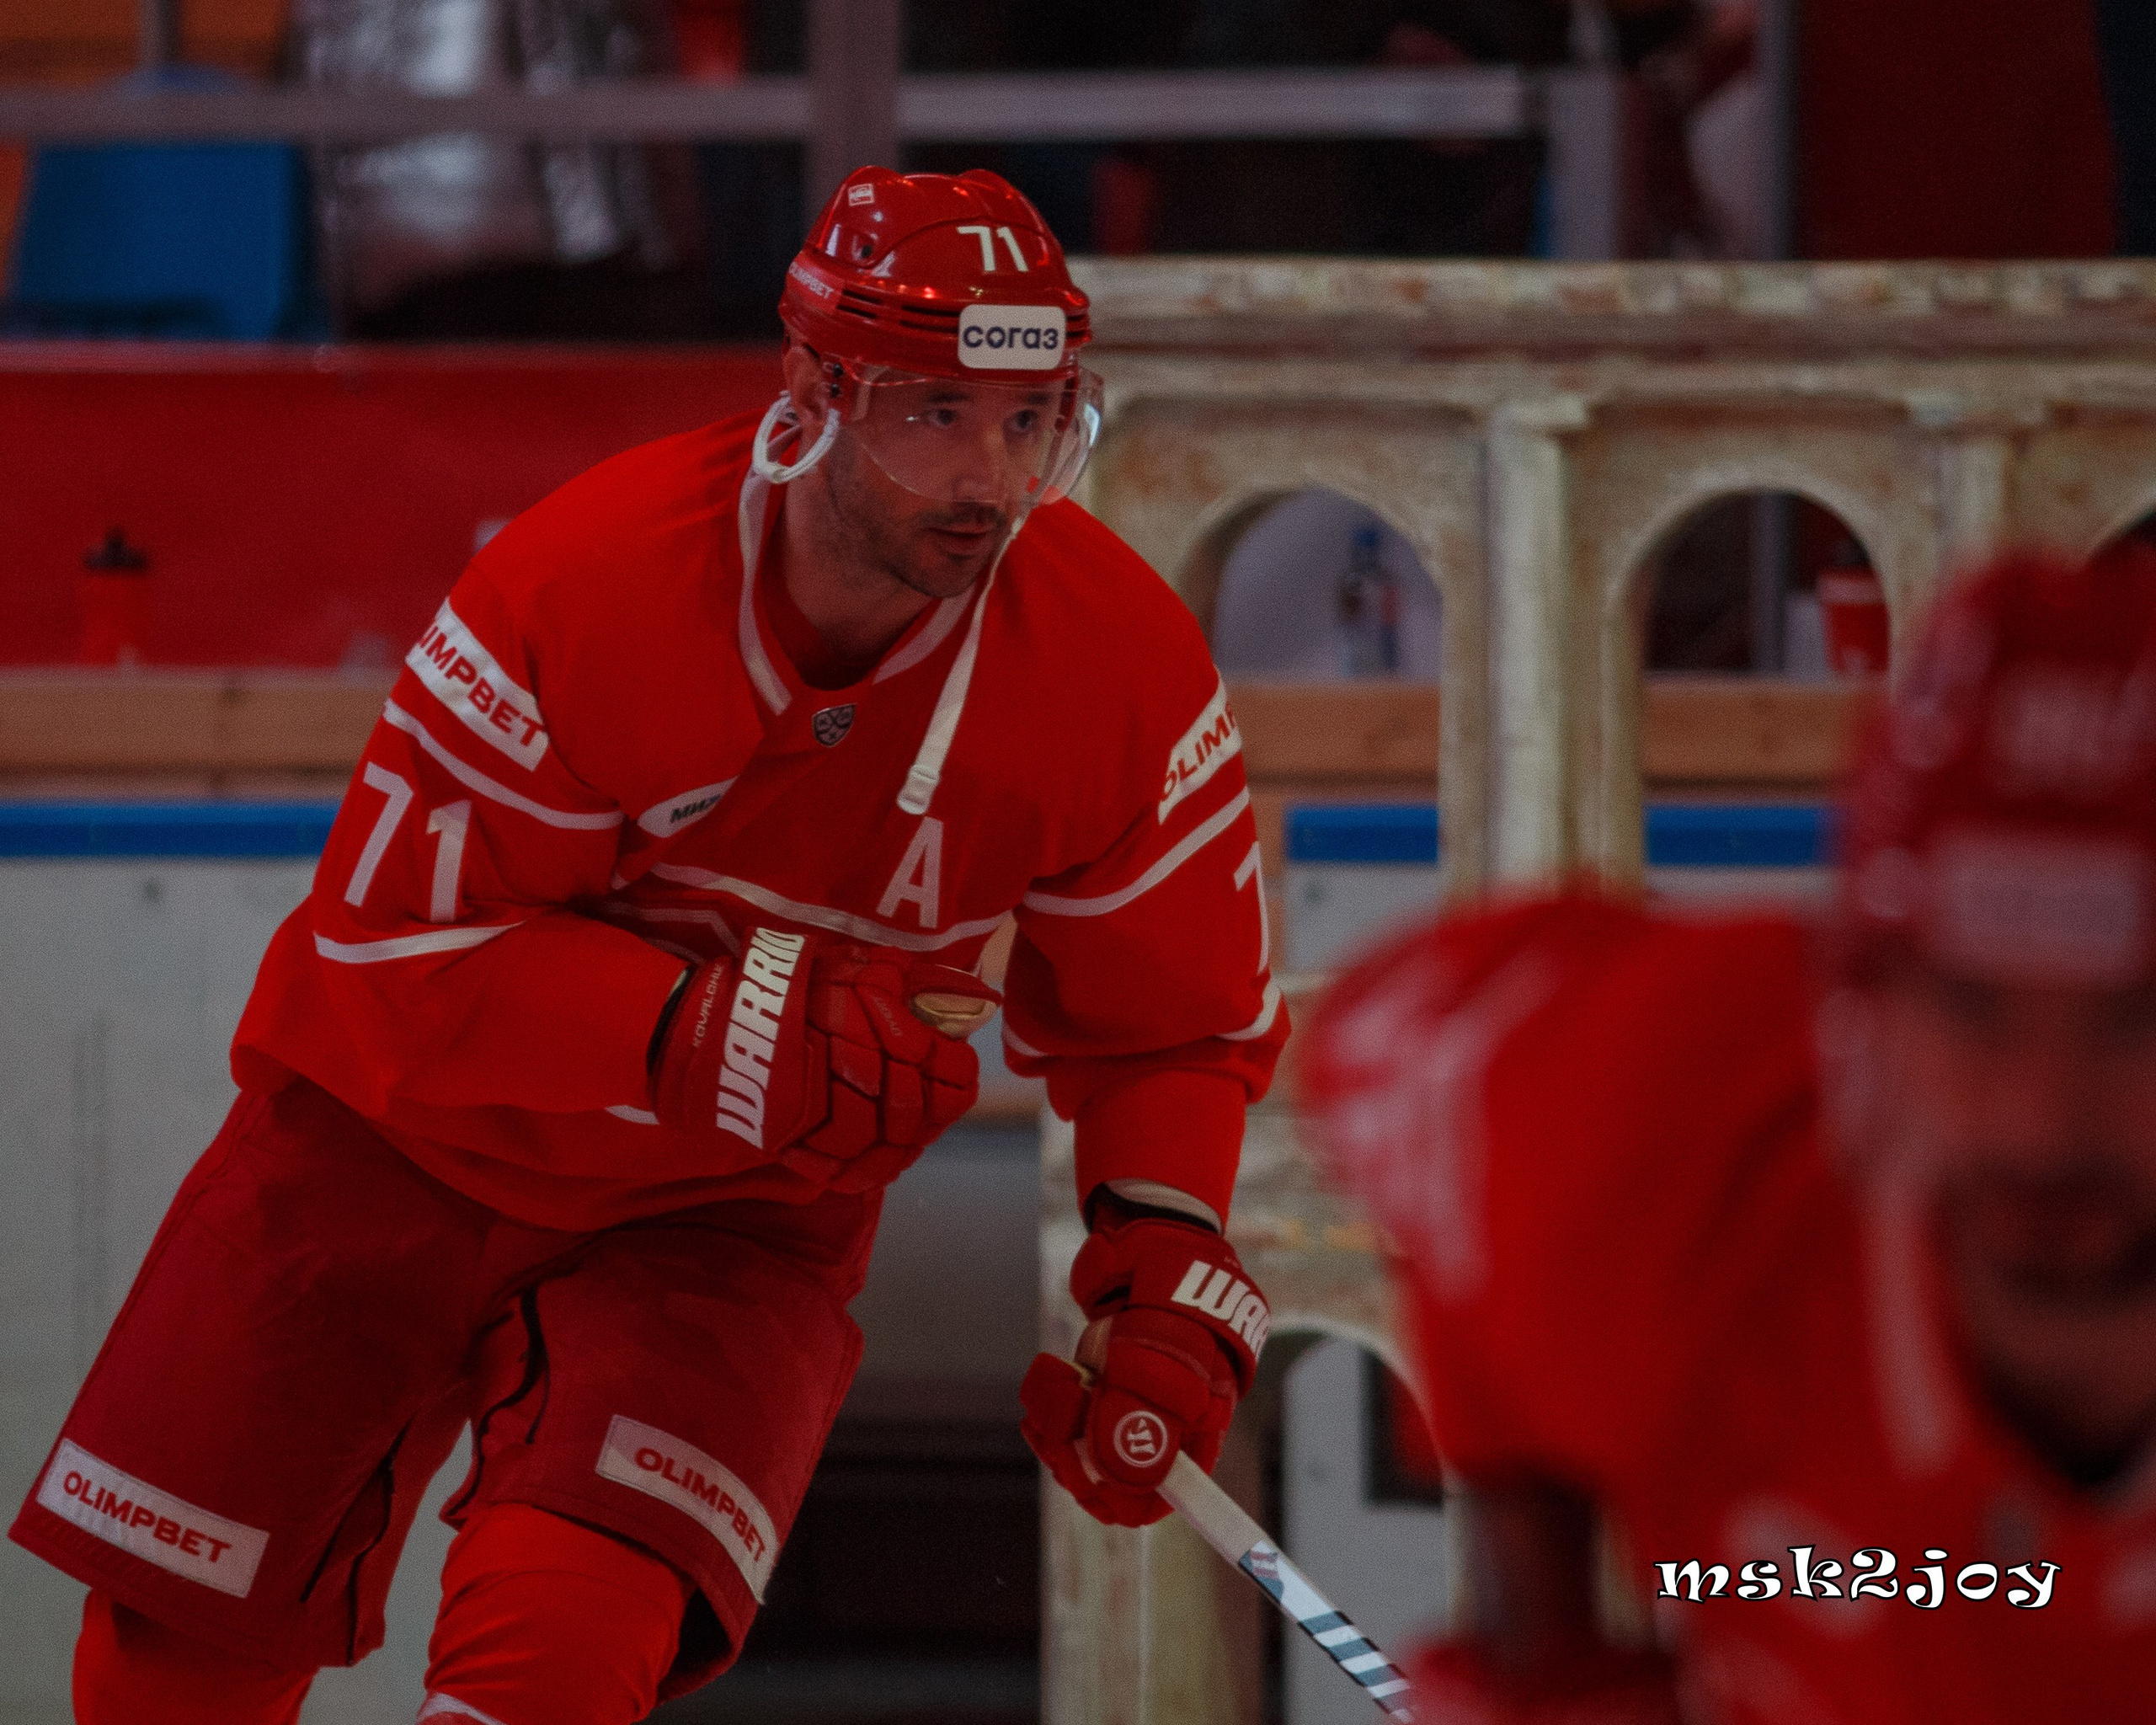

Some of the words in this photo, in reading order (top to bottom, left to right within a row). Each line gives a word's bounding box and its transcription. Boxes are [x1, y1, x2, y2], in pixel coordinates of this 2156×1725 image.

[957, 226, 1028, 272] 71
[344, 761, 466, 923] 71
[876, 815, 944, 928] A
[63, 1471, 232, 1563] OLIMPBET
[635, 1447, 766, 1562] OLIMPBET
